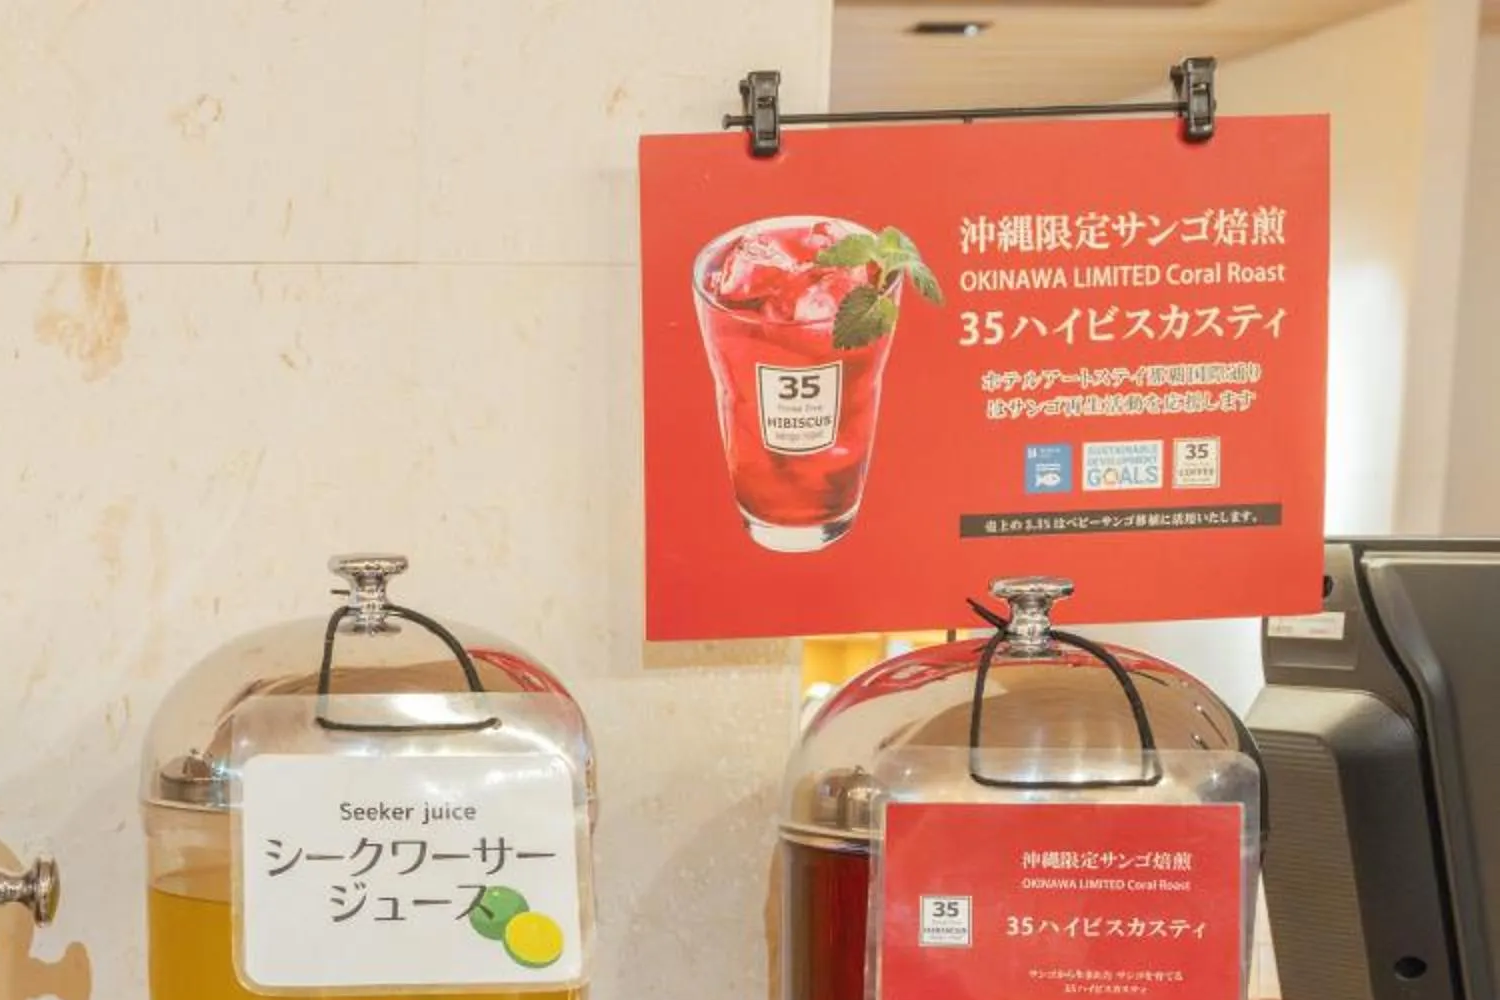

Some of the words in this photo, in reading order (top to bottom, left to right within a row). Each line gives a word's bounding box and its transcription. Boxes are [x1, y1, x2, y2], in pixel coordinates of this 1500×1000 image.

[959, 205, 1287, 254] 沖縄限定サンゴ焙煎
[959, 267, 1068, 292] OKINAWA
[1073, 264, 1161, 288] LIMITED
[1165, 262, 1221, 286] Coral
[1226, 260, 1286, 284] Roast
[959, 303, 1288, 346] 35ハイビスカスティ
[778, 375, 821, 400] 35
[767, 415, 832, 429] HIBISCUS
[1185, 443, 1210, 460] 35
[1087, 466, 1158, 486] GOALS
[339, 802, 415, 821] Seeker
[421, 803, 477, 825] juice
[266, 837, 556, 877] シークワーサー
[1020, 851, 1193, 871] 沖縄限定サンゴ焙煎
[1021, 877, 1077, 890] OKINAWA
[1079, 878, 1126, 891] LIMITED
[1127, 878, 1159, 891] Coral
[328, 882, 495, 923] ジュース
[932, 901, 959, 918] 35
